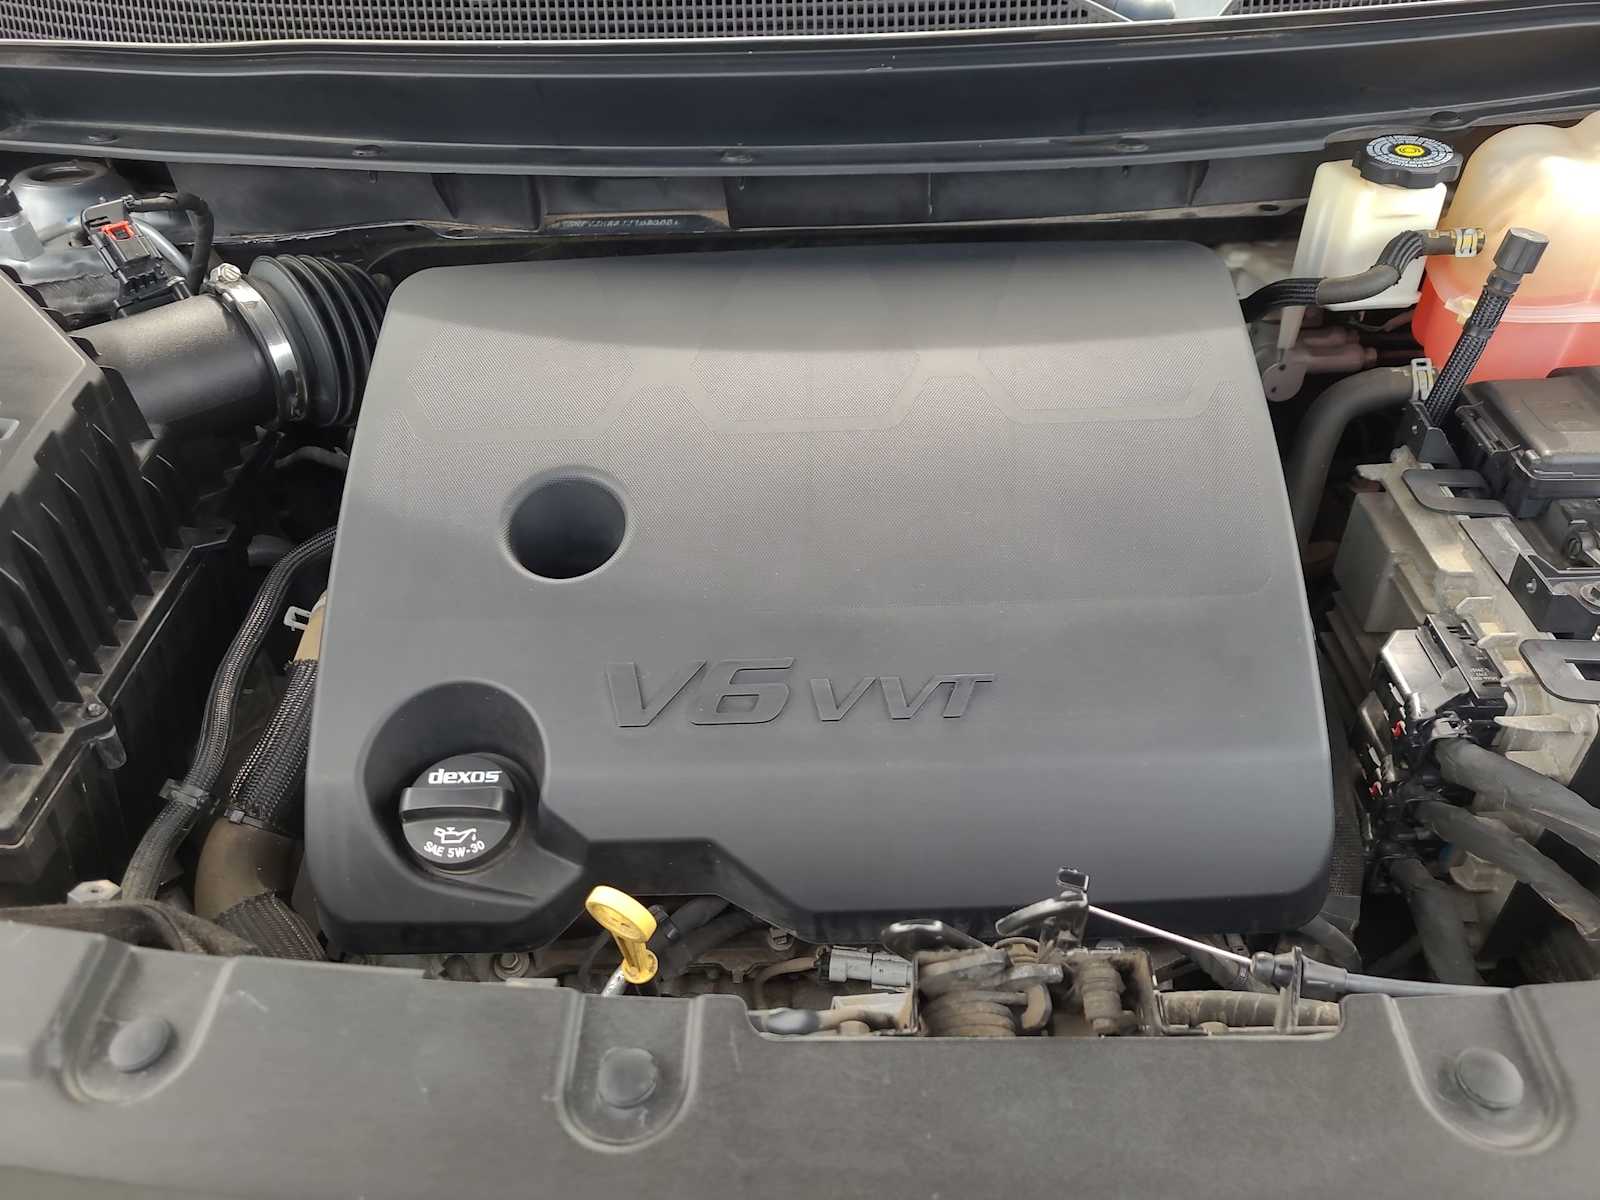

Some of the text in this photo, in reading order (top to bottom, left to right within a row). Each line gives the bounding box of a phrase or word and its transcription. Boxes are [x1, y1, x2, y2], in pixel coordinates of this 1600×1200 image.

[606, 657, 994, 728] V6 VVT
[428, 768, 503, 784] dexos
[423, 840, 486, 858] SAE 5W-30
